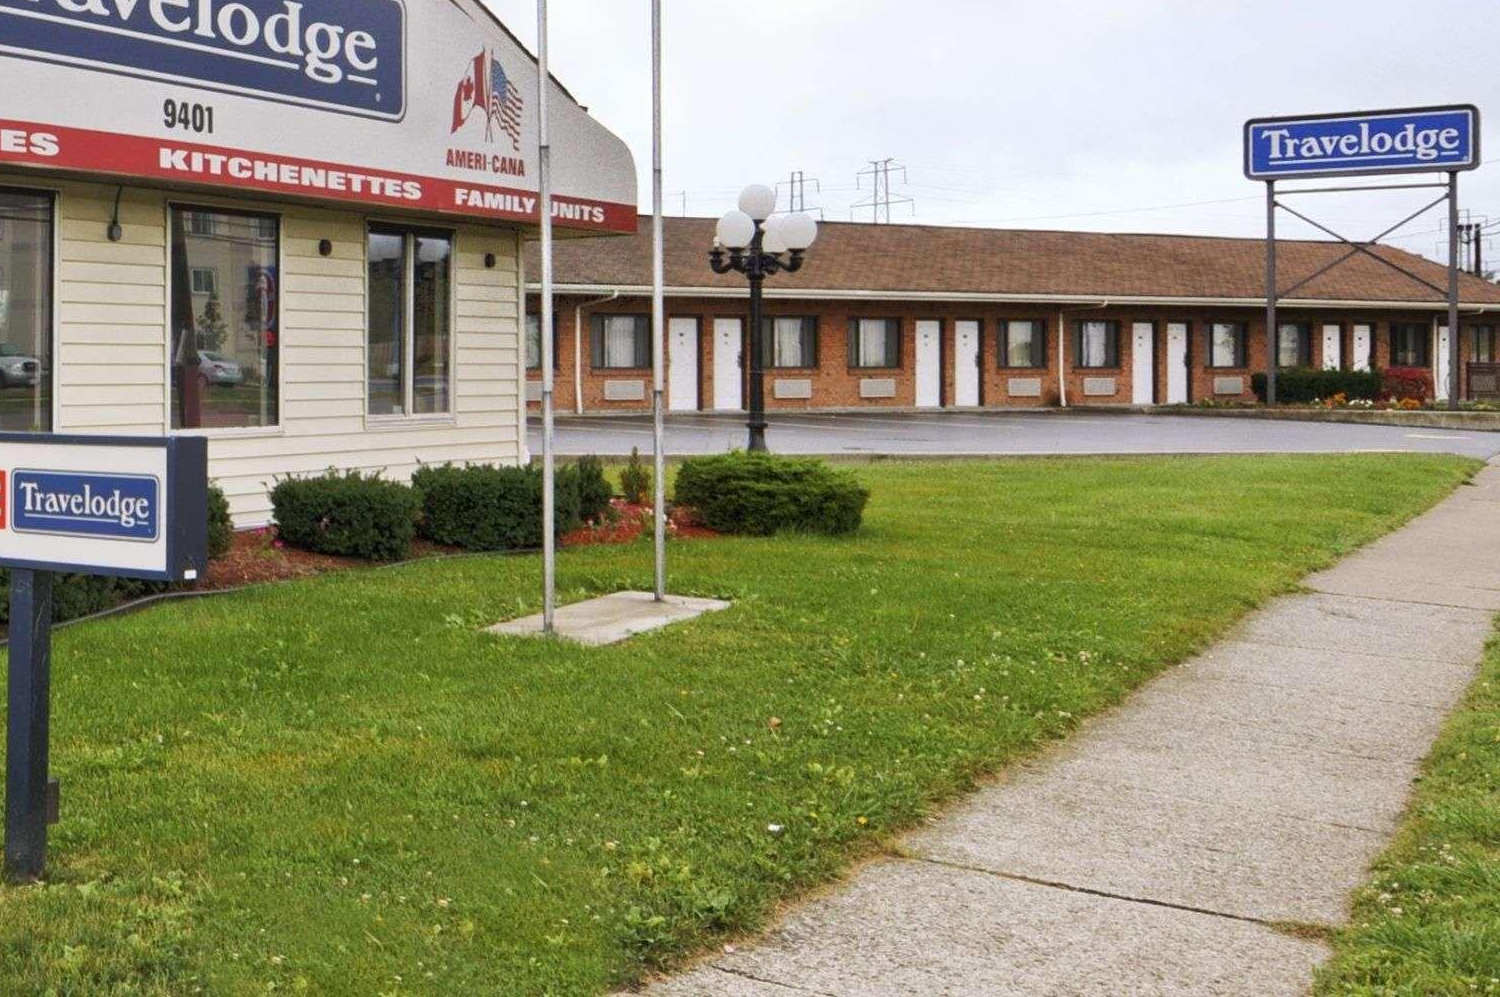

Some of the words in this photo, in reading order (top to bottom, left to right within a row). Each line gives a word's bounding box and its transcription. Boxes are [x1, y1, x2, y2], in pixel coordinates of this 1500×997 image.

[163, 98, 214, 134] 9401
[1261, 123, 1460, 161] Travelodge
[159, 147, 422, 200] KITCHENETTES
[455, 188, 536, 215] FAMILY
[446, 148, 525, 177] AMERI-CANA
[19, 481, 150, 527] Travelodge
